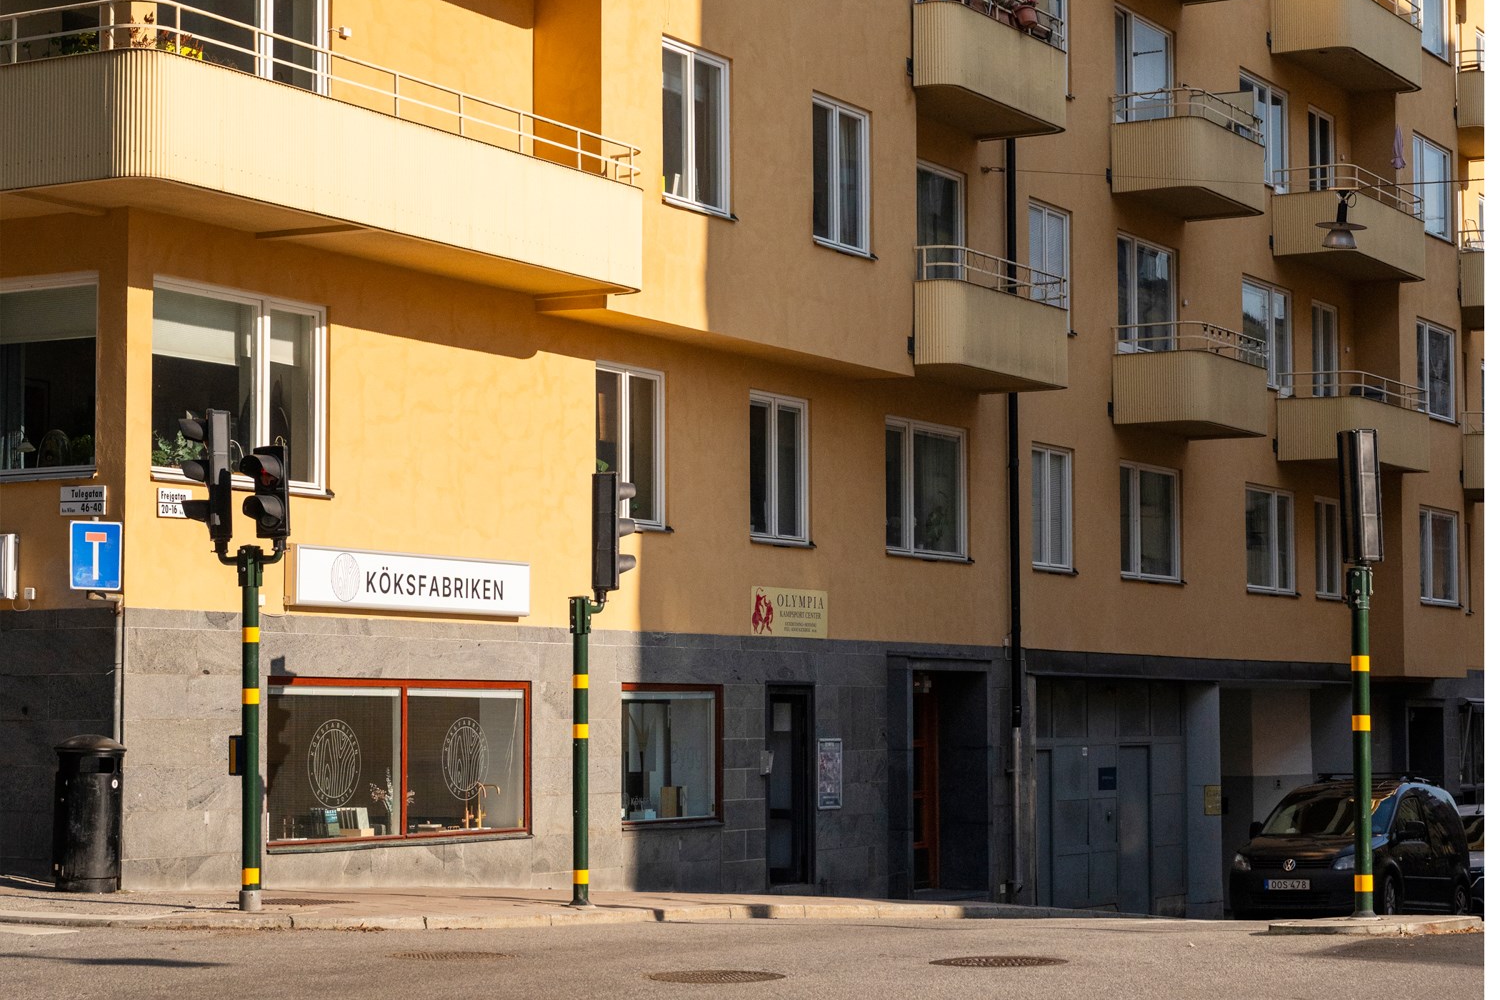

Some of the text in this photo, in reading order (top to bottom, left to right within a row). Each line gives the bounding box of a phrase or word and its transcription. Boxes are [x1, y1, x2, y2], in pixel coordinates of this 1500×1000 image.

[71, 489, 103, 500] Tulegatan
[160, 490, 187, 502] Frejgatan
[80, 502, 103, 512] 46-40
[161, 504, 178, 514] 20-16
[365, 566, 504, 601] KÖKSFABRIKEN
[776, 594, 824, 610] OLYMPIA
[779, 610, 822, 620] KAMPSPORT CENTER
[1271, 880, 1307, 889] OOS 478
